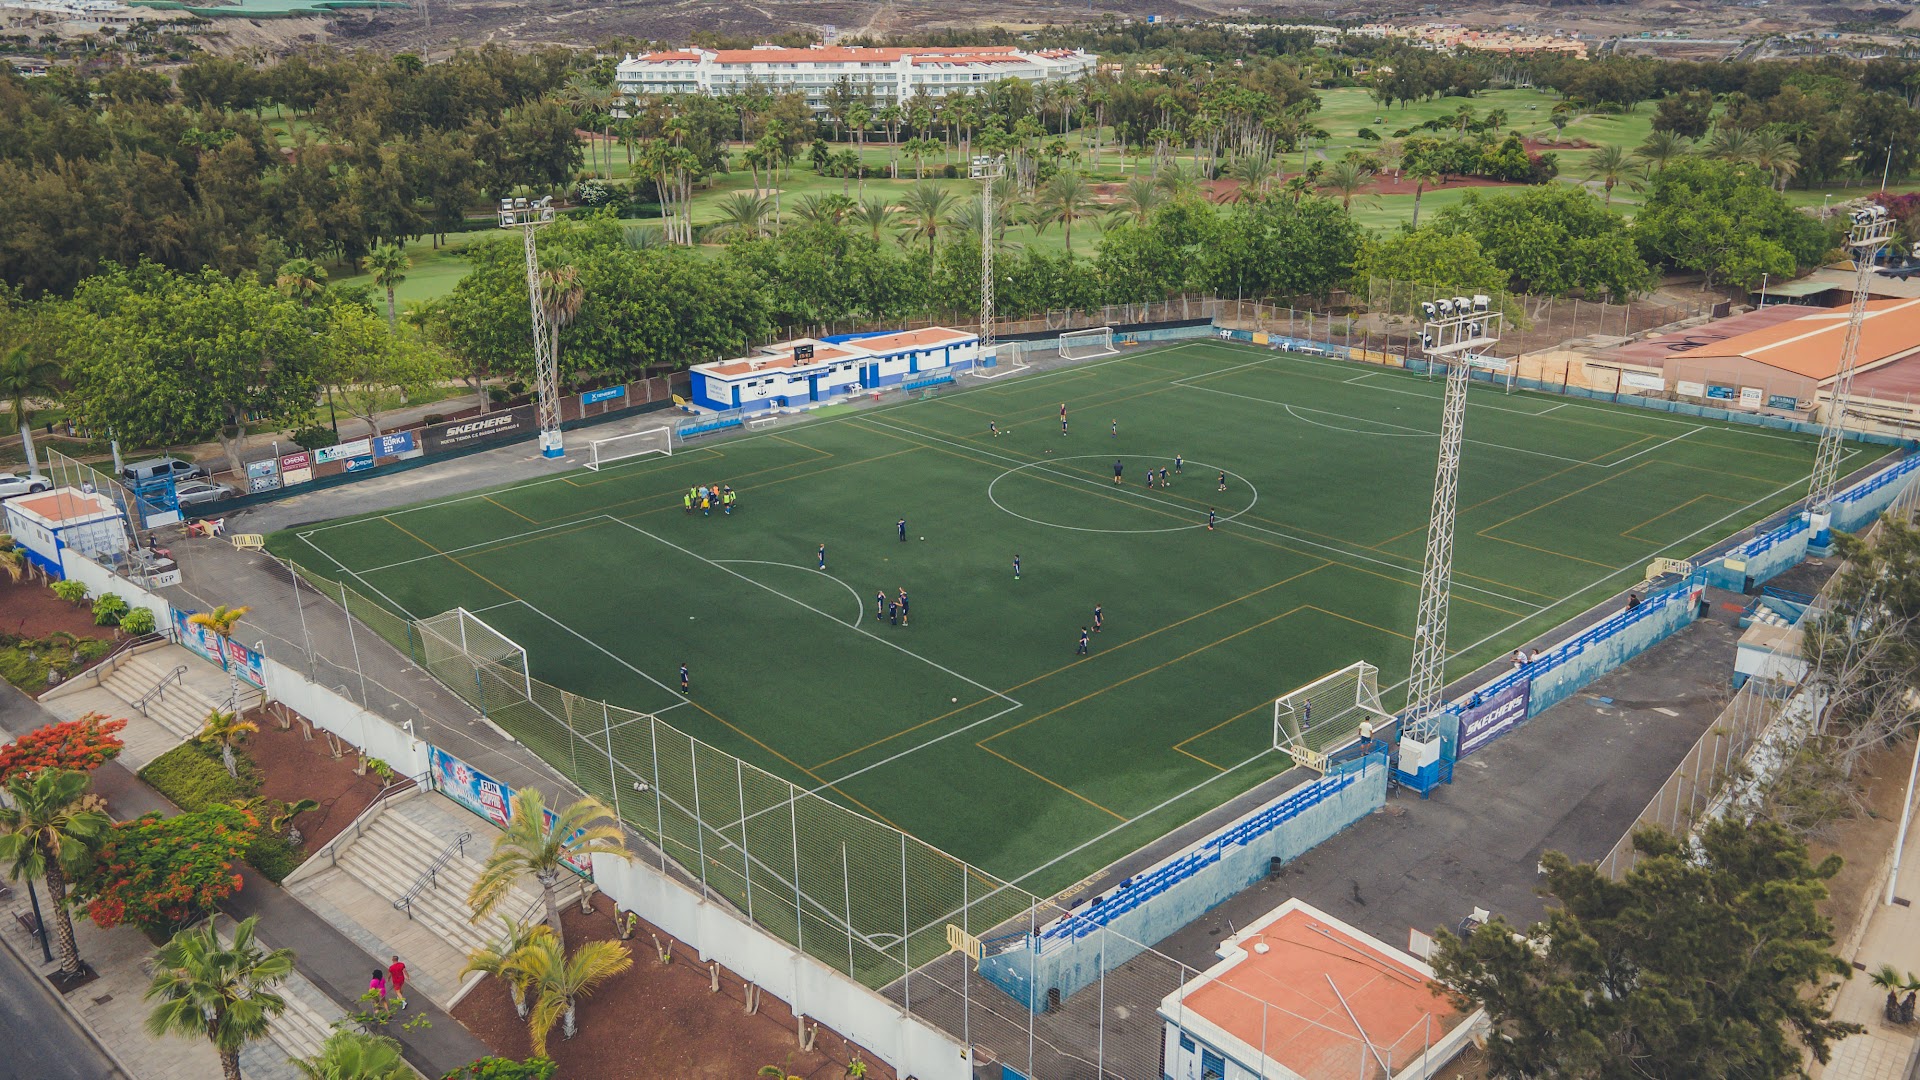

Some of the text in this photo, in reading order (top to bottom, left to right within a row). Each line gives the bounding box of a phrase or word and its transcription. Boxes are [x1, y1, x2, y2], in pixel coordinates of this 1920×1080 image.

[446, 414, 513, 437] SKECHERS
[383, 436, 405, 447] GORKA
[250, 460, 274, 470] PEPSI
[284, 455, 306, 465] OSOR
[356, 458, 373, 467] pepsi
[160, 574, 174, 584] LFP
[1465, 694, 1524, 737] SKECHERS
[483, 781, 498, 793] FUN
[1058, 884, 1085, 901] CHICLES
